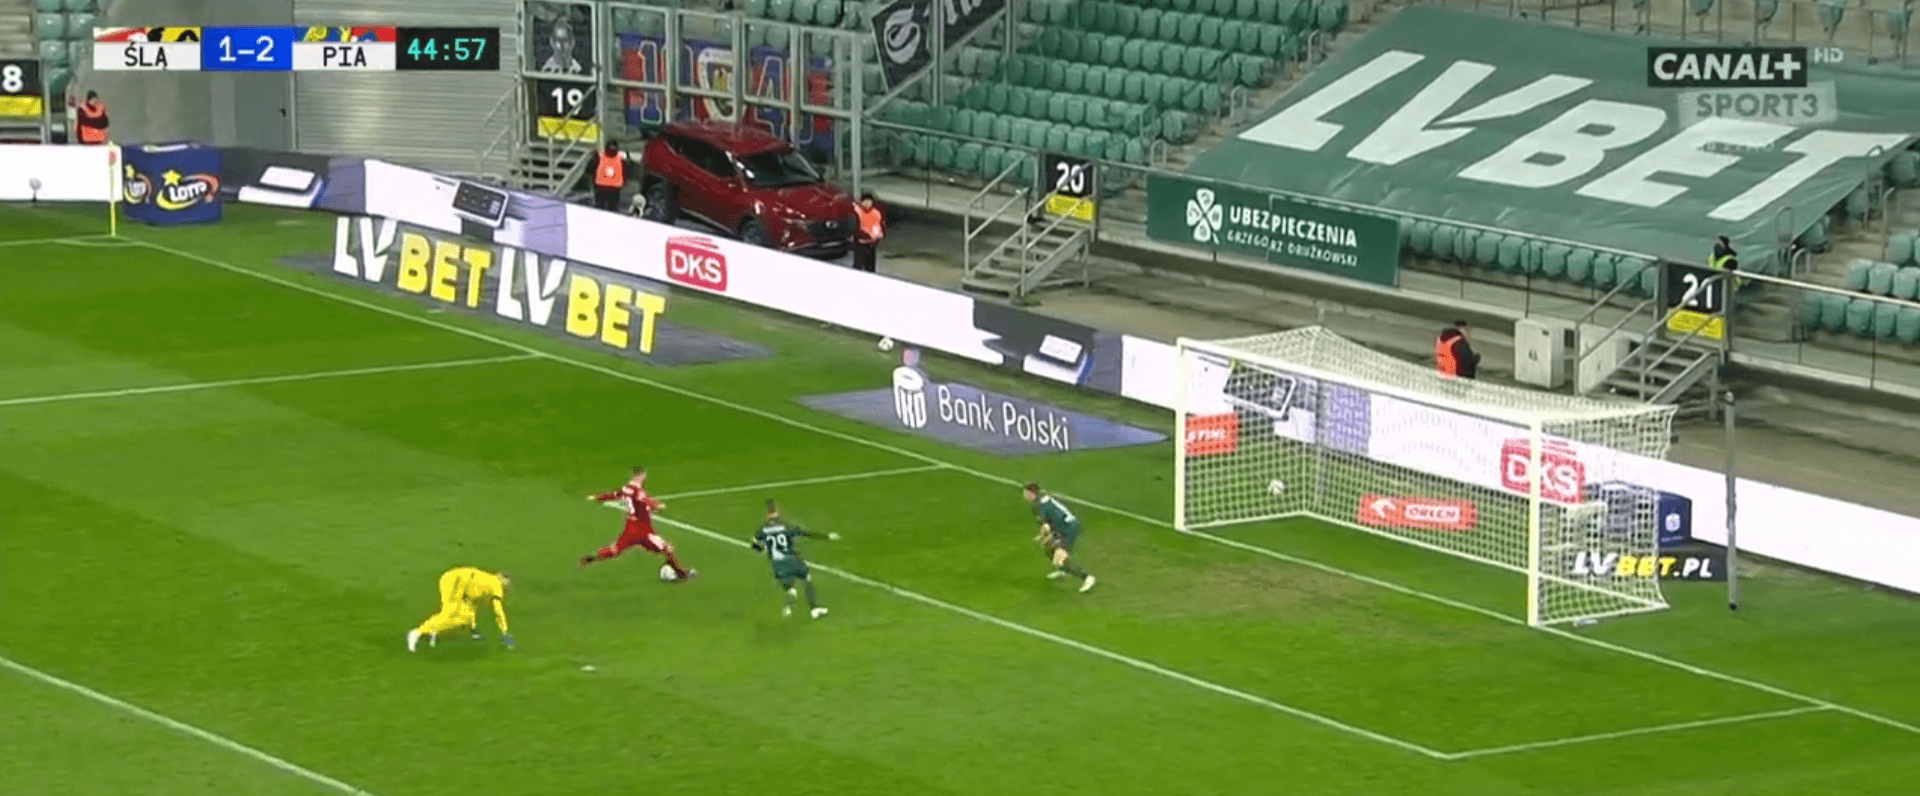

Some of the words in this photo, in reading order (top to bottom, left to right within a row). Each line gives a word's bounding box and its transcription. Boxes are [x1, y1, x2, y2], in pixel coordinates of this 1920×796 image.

[551, 87, 583, 115] 19
[1055, 162, 1084, 193] 20
[1229, 205, 1357, 248] UBEZPIECZENIA
[671, 249, 722, 285] DKS
[1681, 272, 1713, 309] 21
[938, 385, 996, 432] Bank
[1003, 401, 1069, 450] Polski
[765, 533, 788, 559] 29
